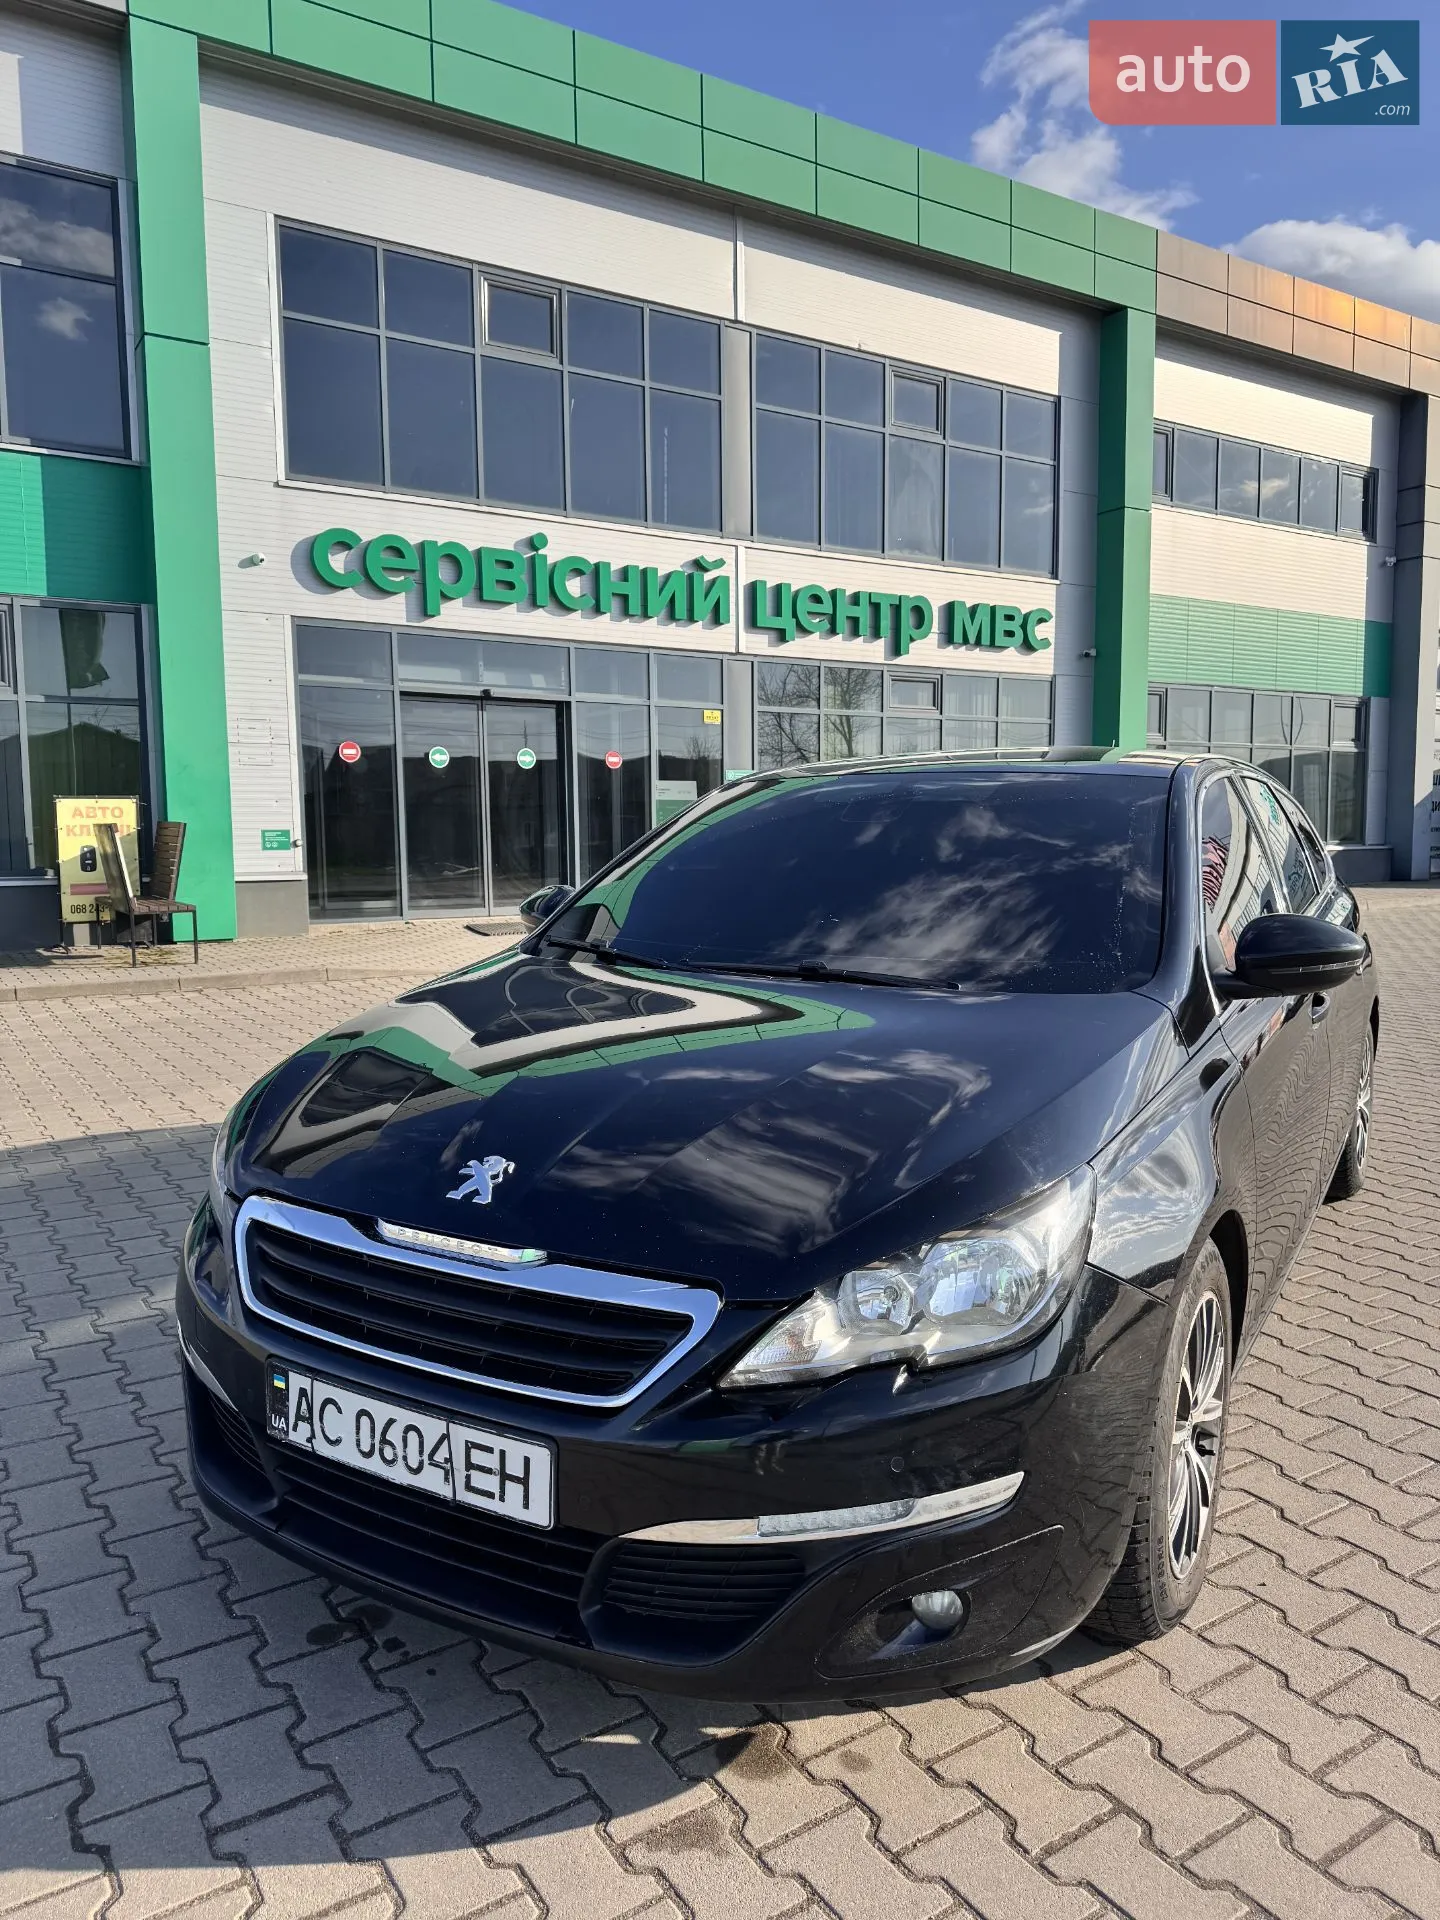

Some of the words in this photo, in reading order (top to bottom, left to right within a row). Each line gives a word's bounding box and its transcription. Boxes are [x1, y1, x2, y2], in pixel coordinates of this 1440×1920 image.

[310, 527, 731, 625] сервісний
[752, 579, 934, 656] центр
[71, 806, 124, 818] АВТО
[70, 904, 87, 914] 068
[271, 1415, 287, 1430] UA
[292, 1386, 344, 1447] AC
[354, 1408, 452, 1486] 0604
[464, 1439, 531, 1510] EH
